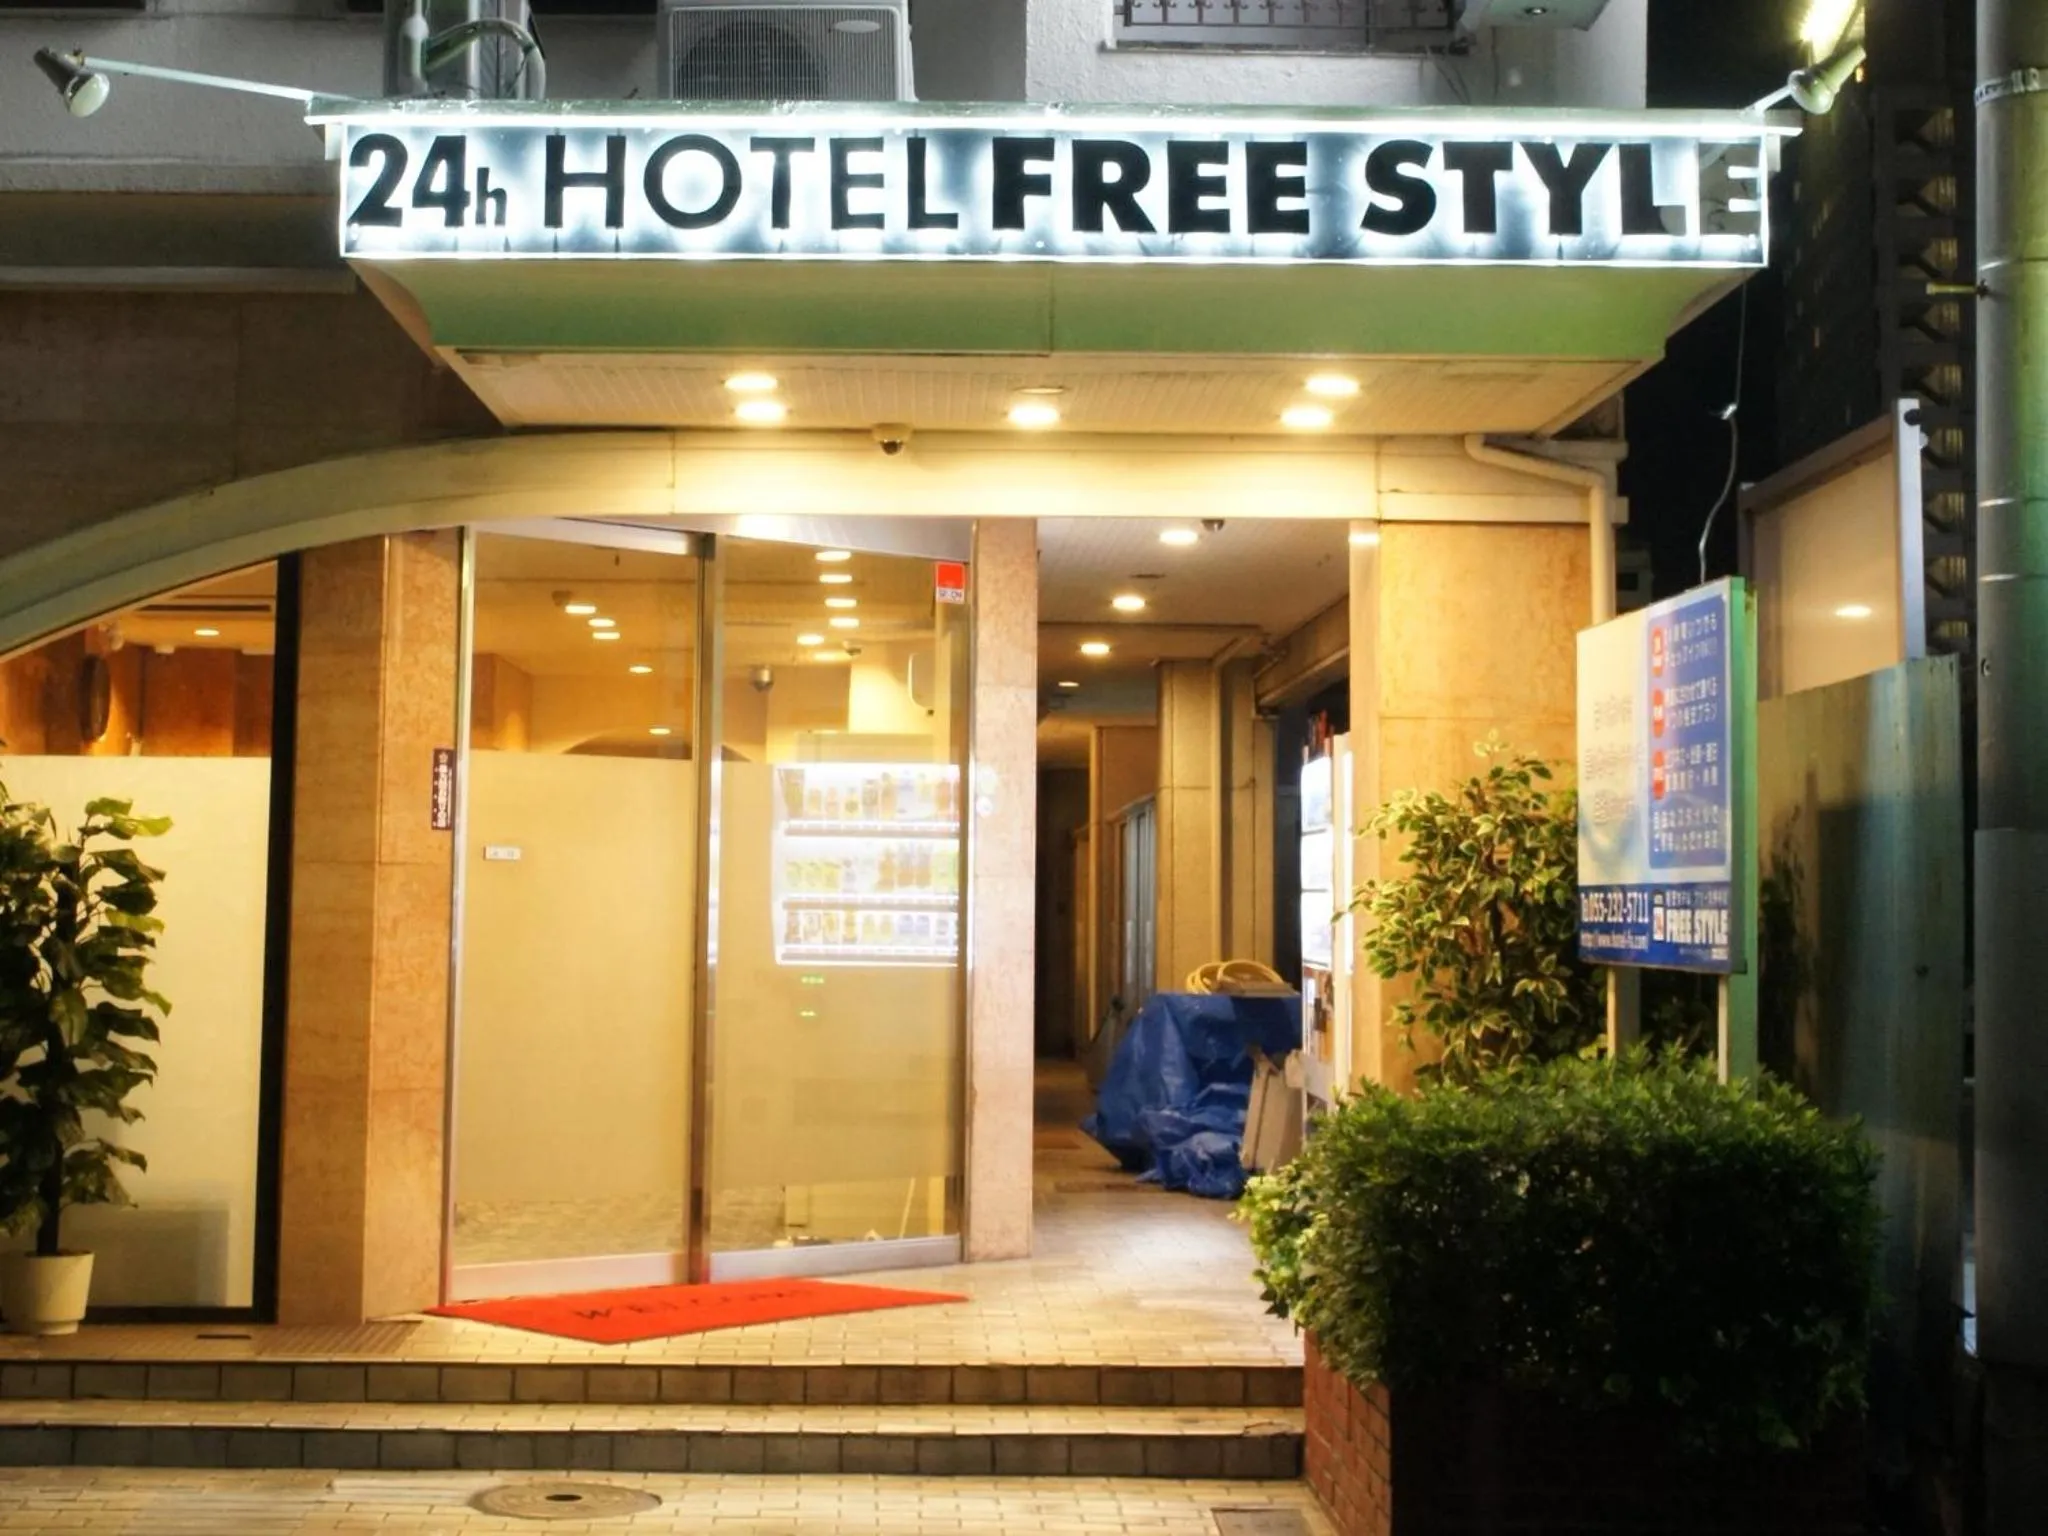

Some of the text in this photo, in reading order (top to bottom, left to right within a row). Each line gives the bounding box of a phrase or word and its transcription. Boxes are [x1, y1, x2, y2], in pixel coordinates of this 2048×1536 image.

[347, 133, 1760, 236] 24h HOTEL FREE STYLE
[1666, 908, 1729, 944] FREE STYLE
